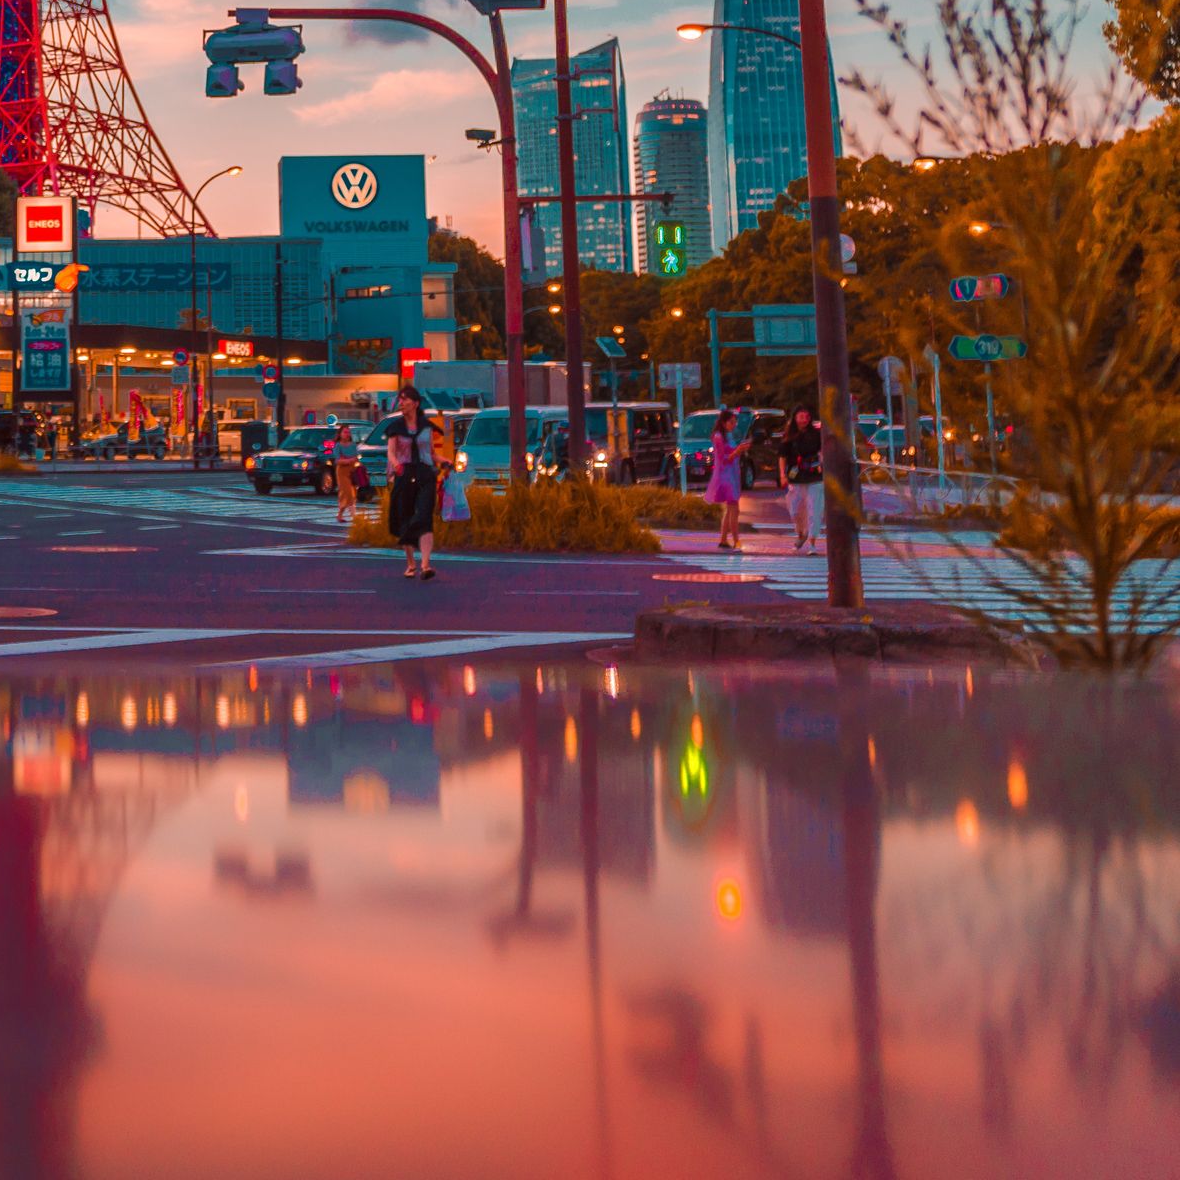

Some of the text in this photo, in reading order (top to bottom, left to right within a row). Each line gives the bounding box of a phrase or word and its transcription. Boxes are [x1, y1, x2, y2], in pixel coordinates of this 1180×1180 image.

[28, 220, 61, 229] ENEOS
[304, 221, 409, 233] VOLKSWAGEN
[14, 268, 53, 283] セルフ
[82, 269, 227, 287] 水素ステーション
[225, 341, 250, 356] ENEOS
